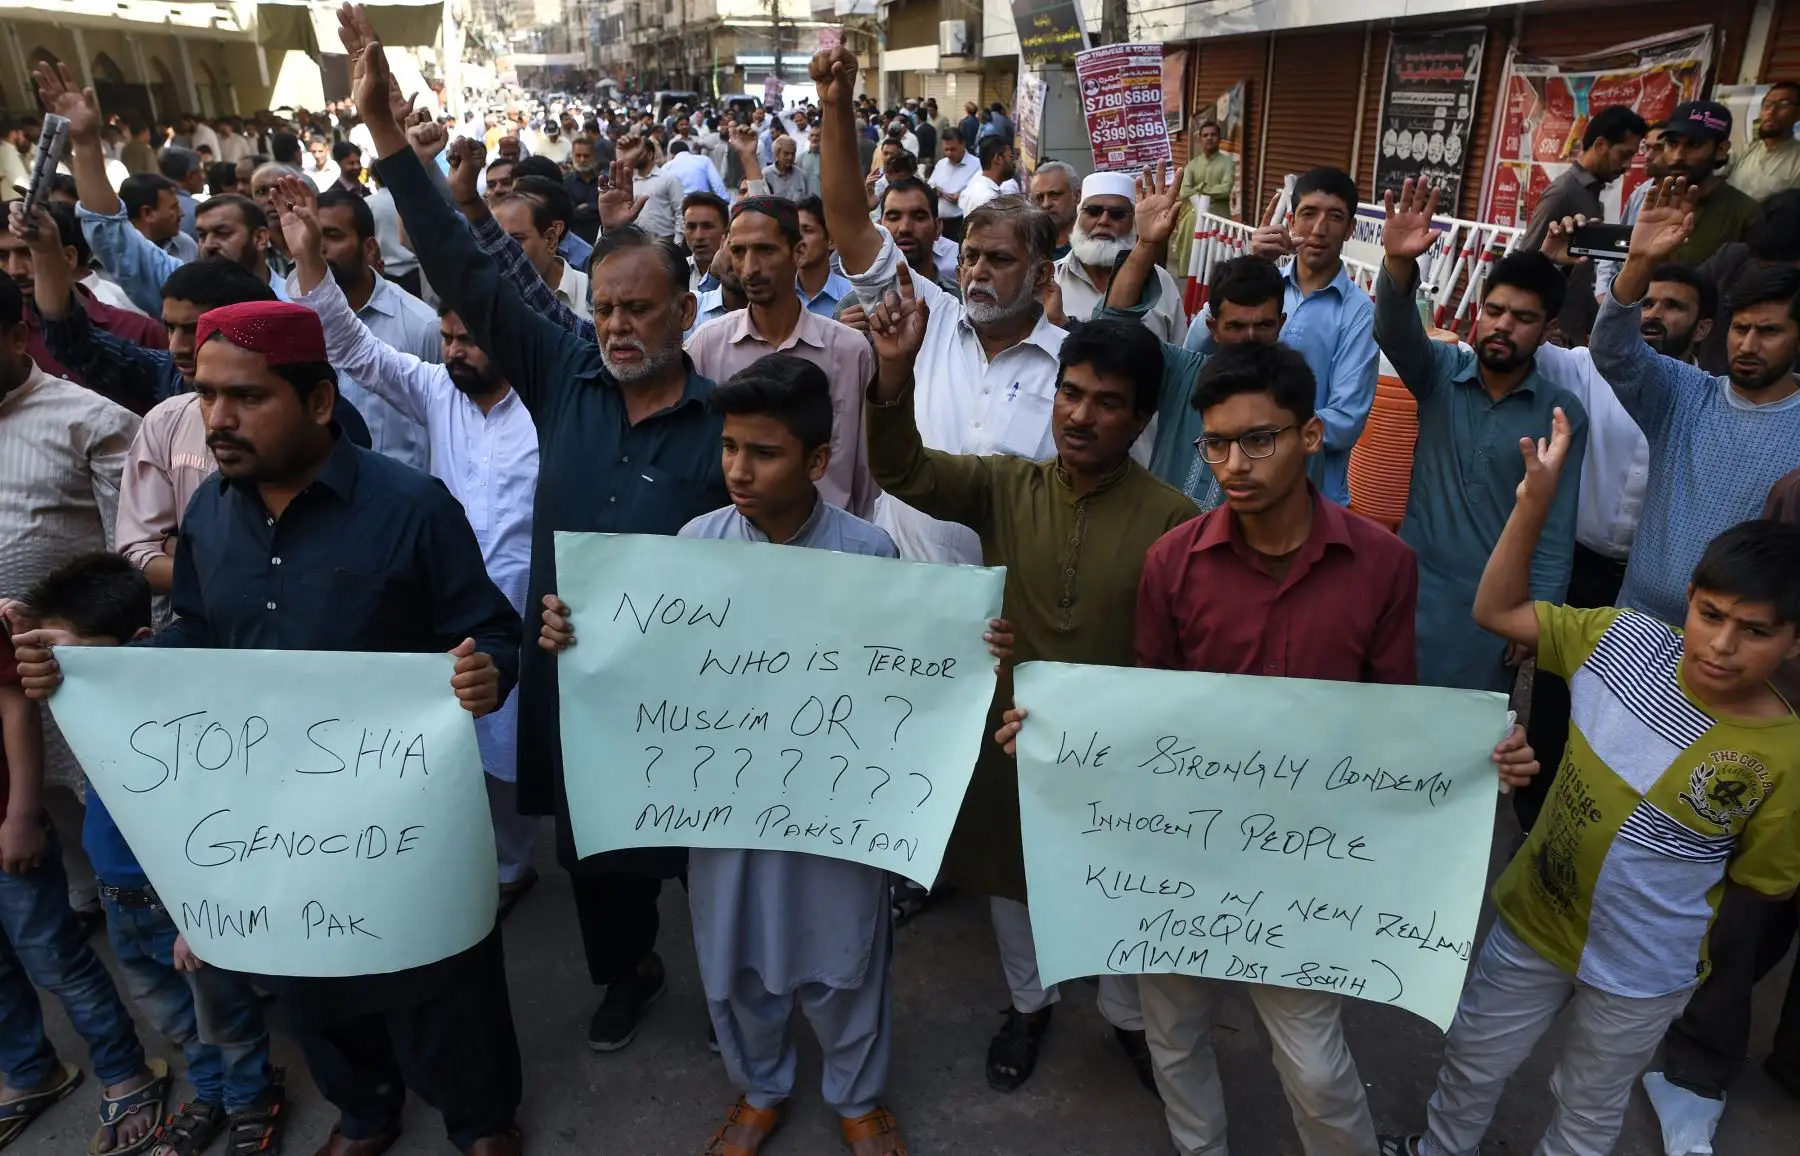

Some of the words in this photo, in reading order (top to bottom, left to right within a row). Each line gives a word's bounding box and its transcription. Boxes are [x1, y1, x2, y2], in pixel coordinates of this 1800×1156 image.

[1091, 46, 1124, 58] TRAVELS
[1133, 44, 1161, 53] TOURS
[1086, 93, 1122, 112] $780
[1124, 89, 1160, 104] $680
[1092, 127, 1126, 144] $399
[1128, 122, 1165, 139] $695
[612, 592, 731, 634] NOW
[700, 648, 790, 676] WHO
[863, 645, 957, 679] TERROR
[790, 694, 860, 751] OR
[884, 695, 913, 751] ?
[122, 710, 269, 794] STOP
[1056, 731, 1112, 768] WE
[1136, 735, 1310, 791] STRONGLY
[1325, 755, 1452, 807] CONDEMN
[1709, 750, 1739, 763] THE
[1739, 753, 1769, 781] COOL
[634, 803, 733, 833] MWM
[1081, 800, 1224, 851] INNOCENT
[1240, 813, 1375, 862] PEOPLE
[181, 899, 269, 940] MWM
[301, 900, 382, 940] PAK
[1085, 864, 1196, 900] KILLED
[1287, 896, 1364, 931] NEW
[1375, 909, 1473, 961] ZEALAND
[1138, 908, 1285, 949] MOSQUE
